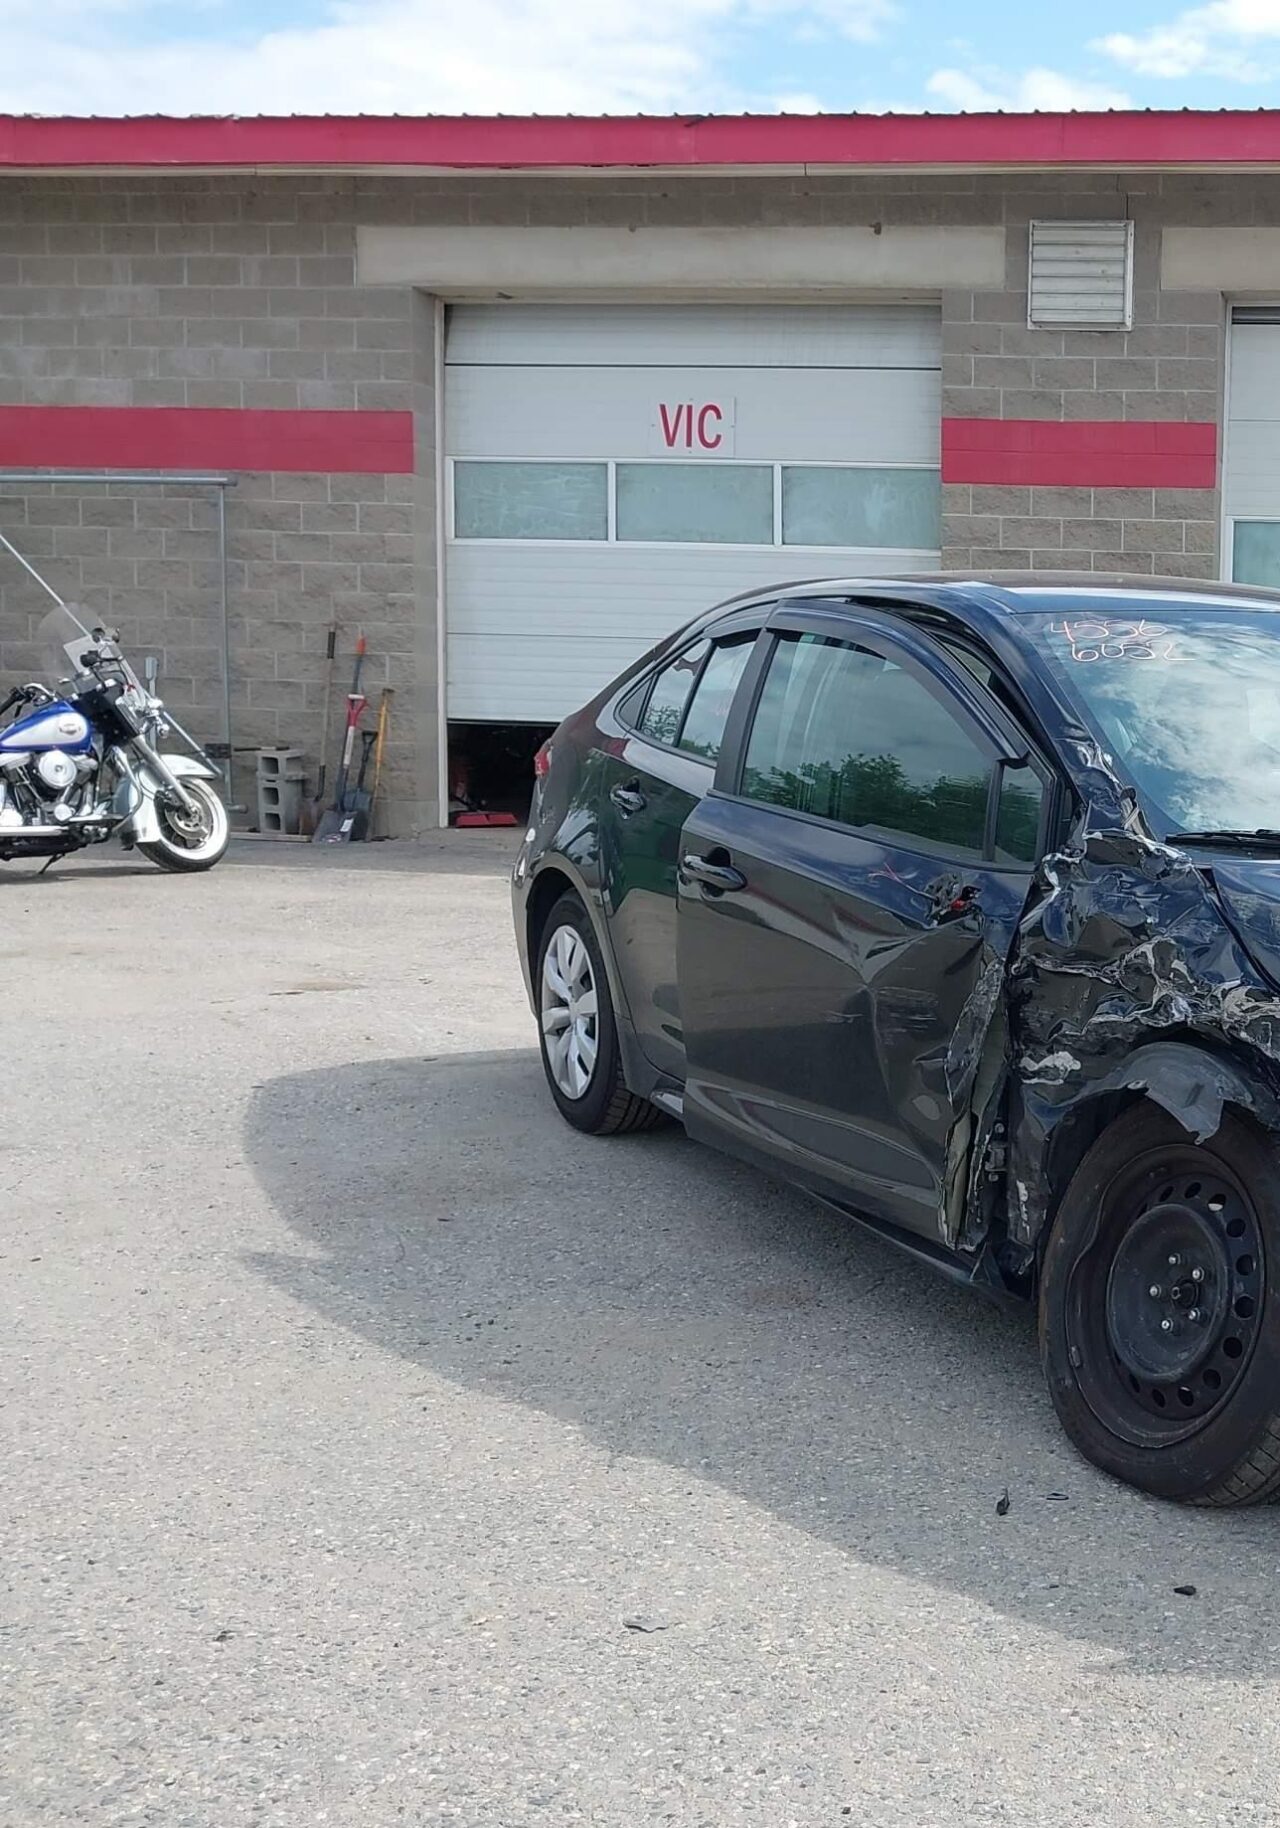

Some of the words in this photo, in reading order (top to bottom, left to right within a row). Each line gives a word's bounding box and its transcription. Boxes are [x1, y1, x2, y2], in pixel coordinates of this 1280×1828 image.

[659, 403, 722, 449] VIC
[1050, 618, 1169, 643] 4556
[1071, 640, 1197, 662] 6052
